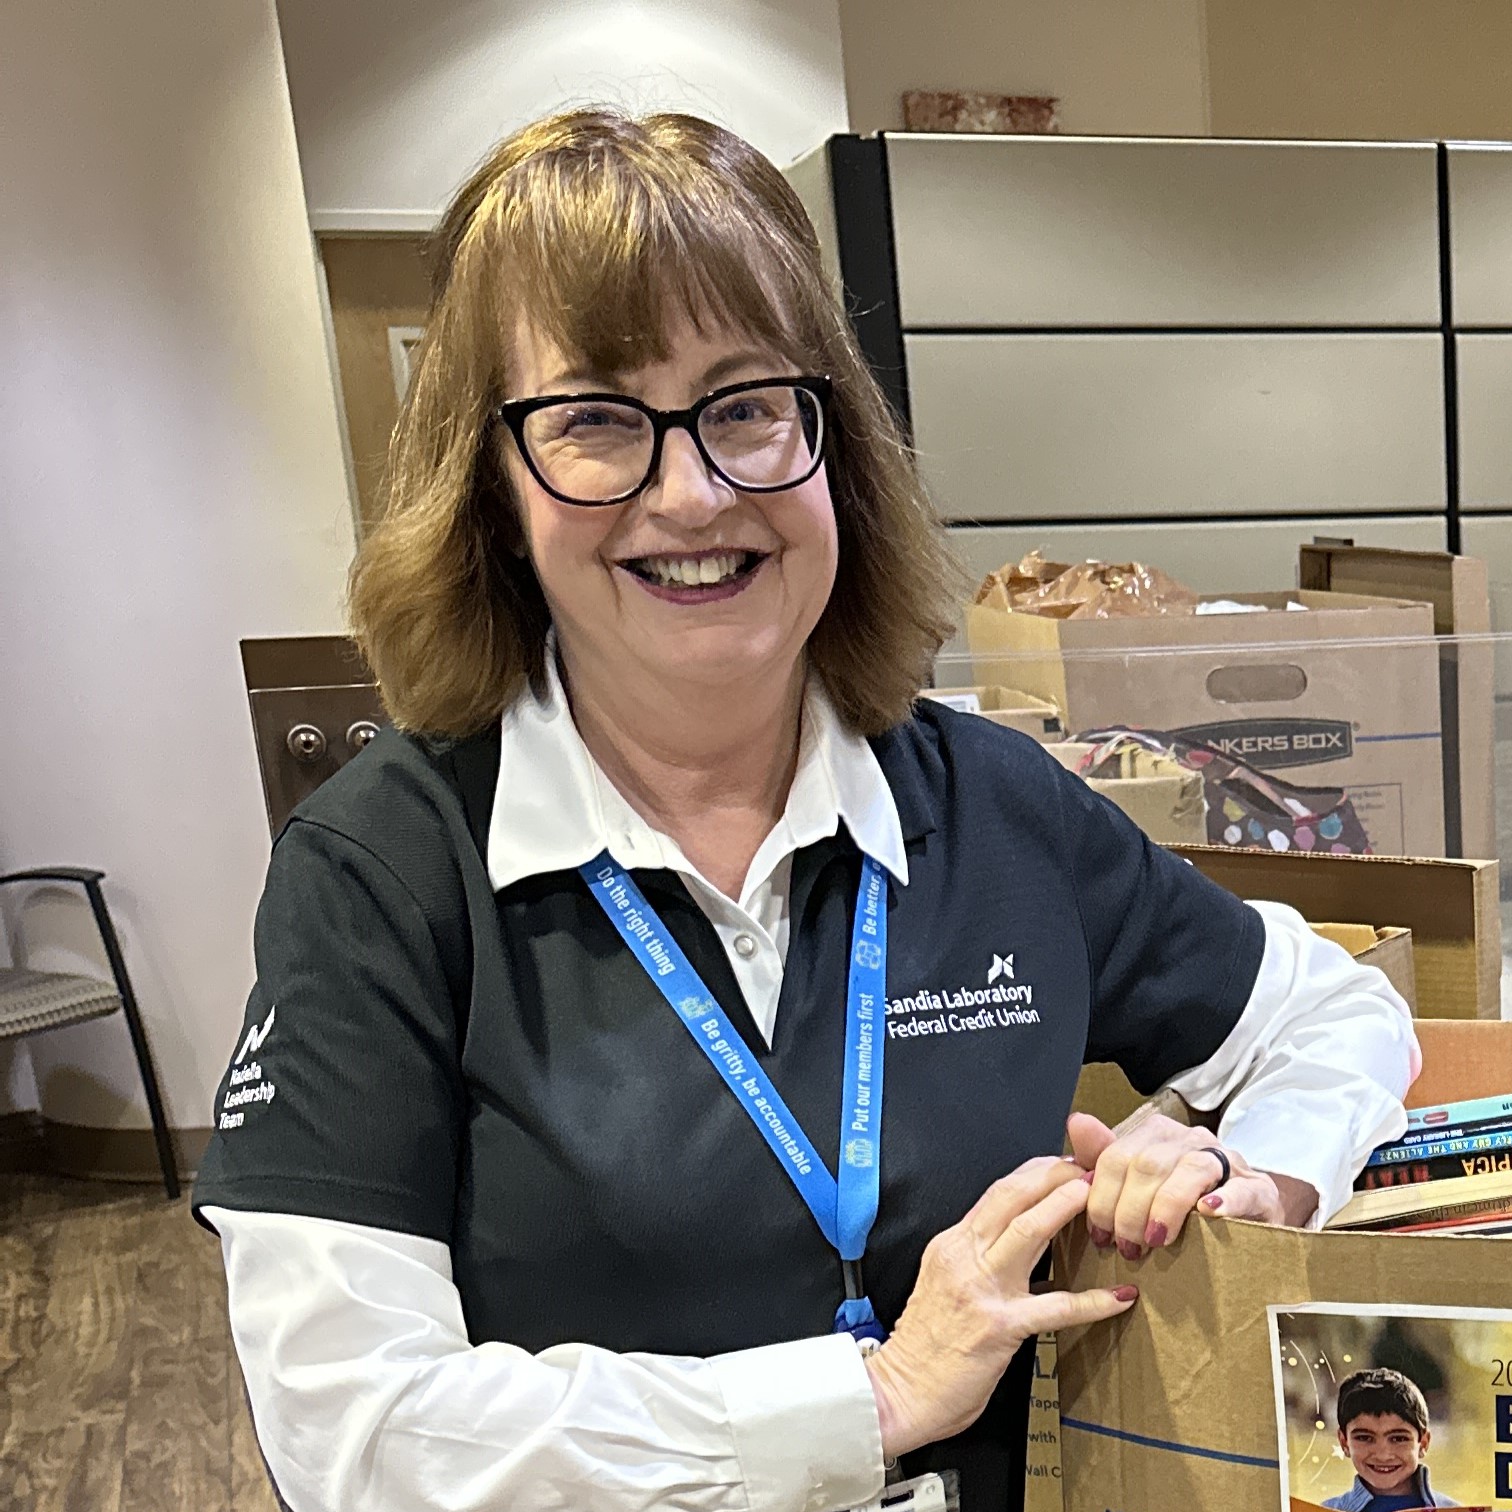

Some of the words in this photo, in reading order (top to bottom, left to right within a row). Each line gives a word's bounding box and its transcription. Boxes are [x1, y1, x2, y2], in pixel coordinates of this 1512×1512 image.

[1294, 732, 1344, 751] BOX
[596, 866, 613, 887] Do
[609, 883, 630, 910] the
[623, 907, 651, 942] right
[644, 936, 676, 976] thing
[862, 920, 878, 936] Be
[858, 993, 874, 1020] first
[884, 990, 942, 1016] Sandia
[942, 984, 1032, 1009] Laboratory
[888, 1014, 948, 1039] Federal
[948, 1008, 996, 1032] Credit
[996, 1005, 1040, 1026] Union
[857, 1022, 872, 1082] members
[224, 1081, 276, 1108] Leadership
[700, 1018, 721, 1040] Be
[712, 1037, 747, 1081] gritty,
[741, 1077, 761, 1097] be
[754, 1097, 813, 1176] accountable
[854, 1082, 870, 1106] our
[851, 1107, 868, 1132] Put
[1028, 1432, 1056, 1444] with
